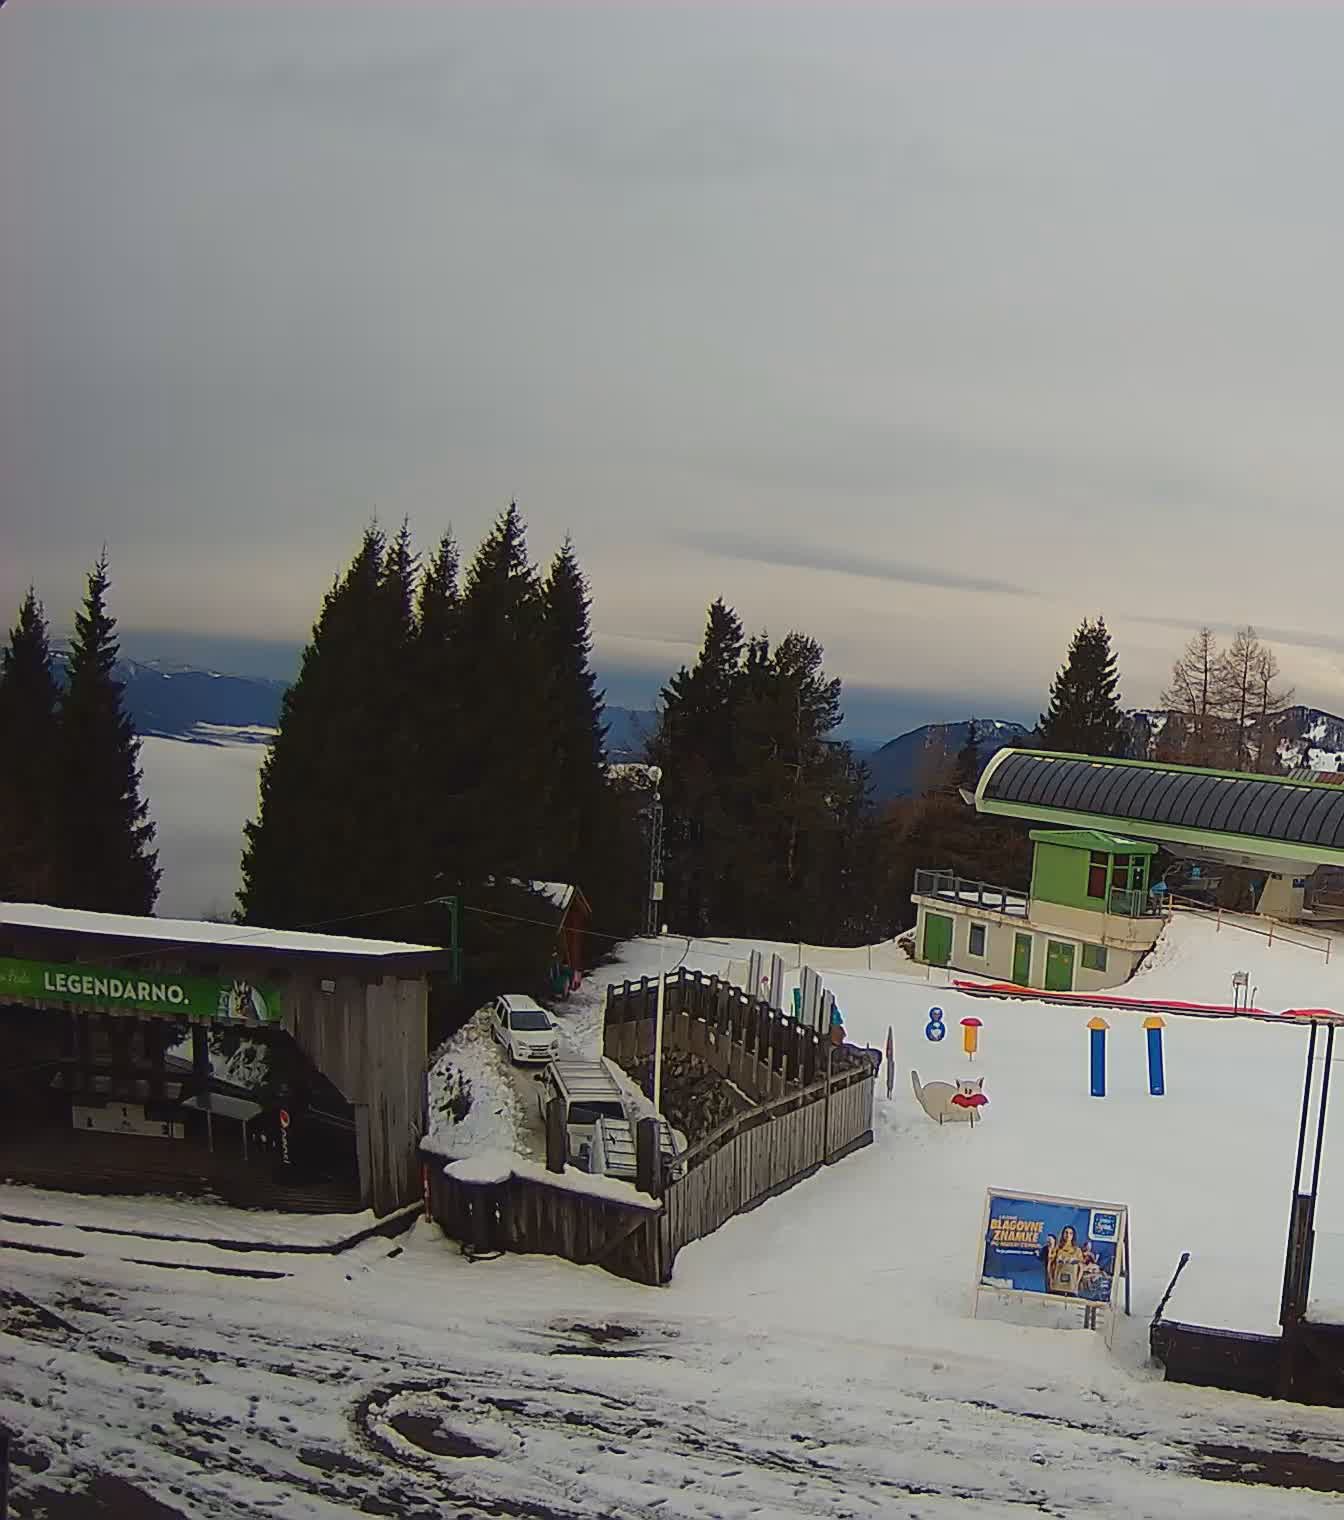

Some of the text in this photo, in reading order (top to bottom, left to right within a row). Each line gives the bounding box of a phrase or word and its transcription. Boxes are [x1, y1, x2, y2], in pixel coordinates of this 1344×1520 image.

[44, 971, 190, 1005] LEGENDARNO.
[990, 1218, 1045, 1233] BLAGOVNE
[992, 1229, 1040, 1243] ZNAMKE
